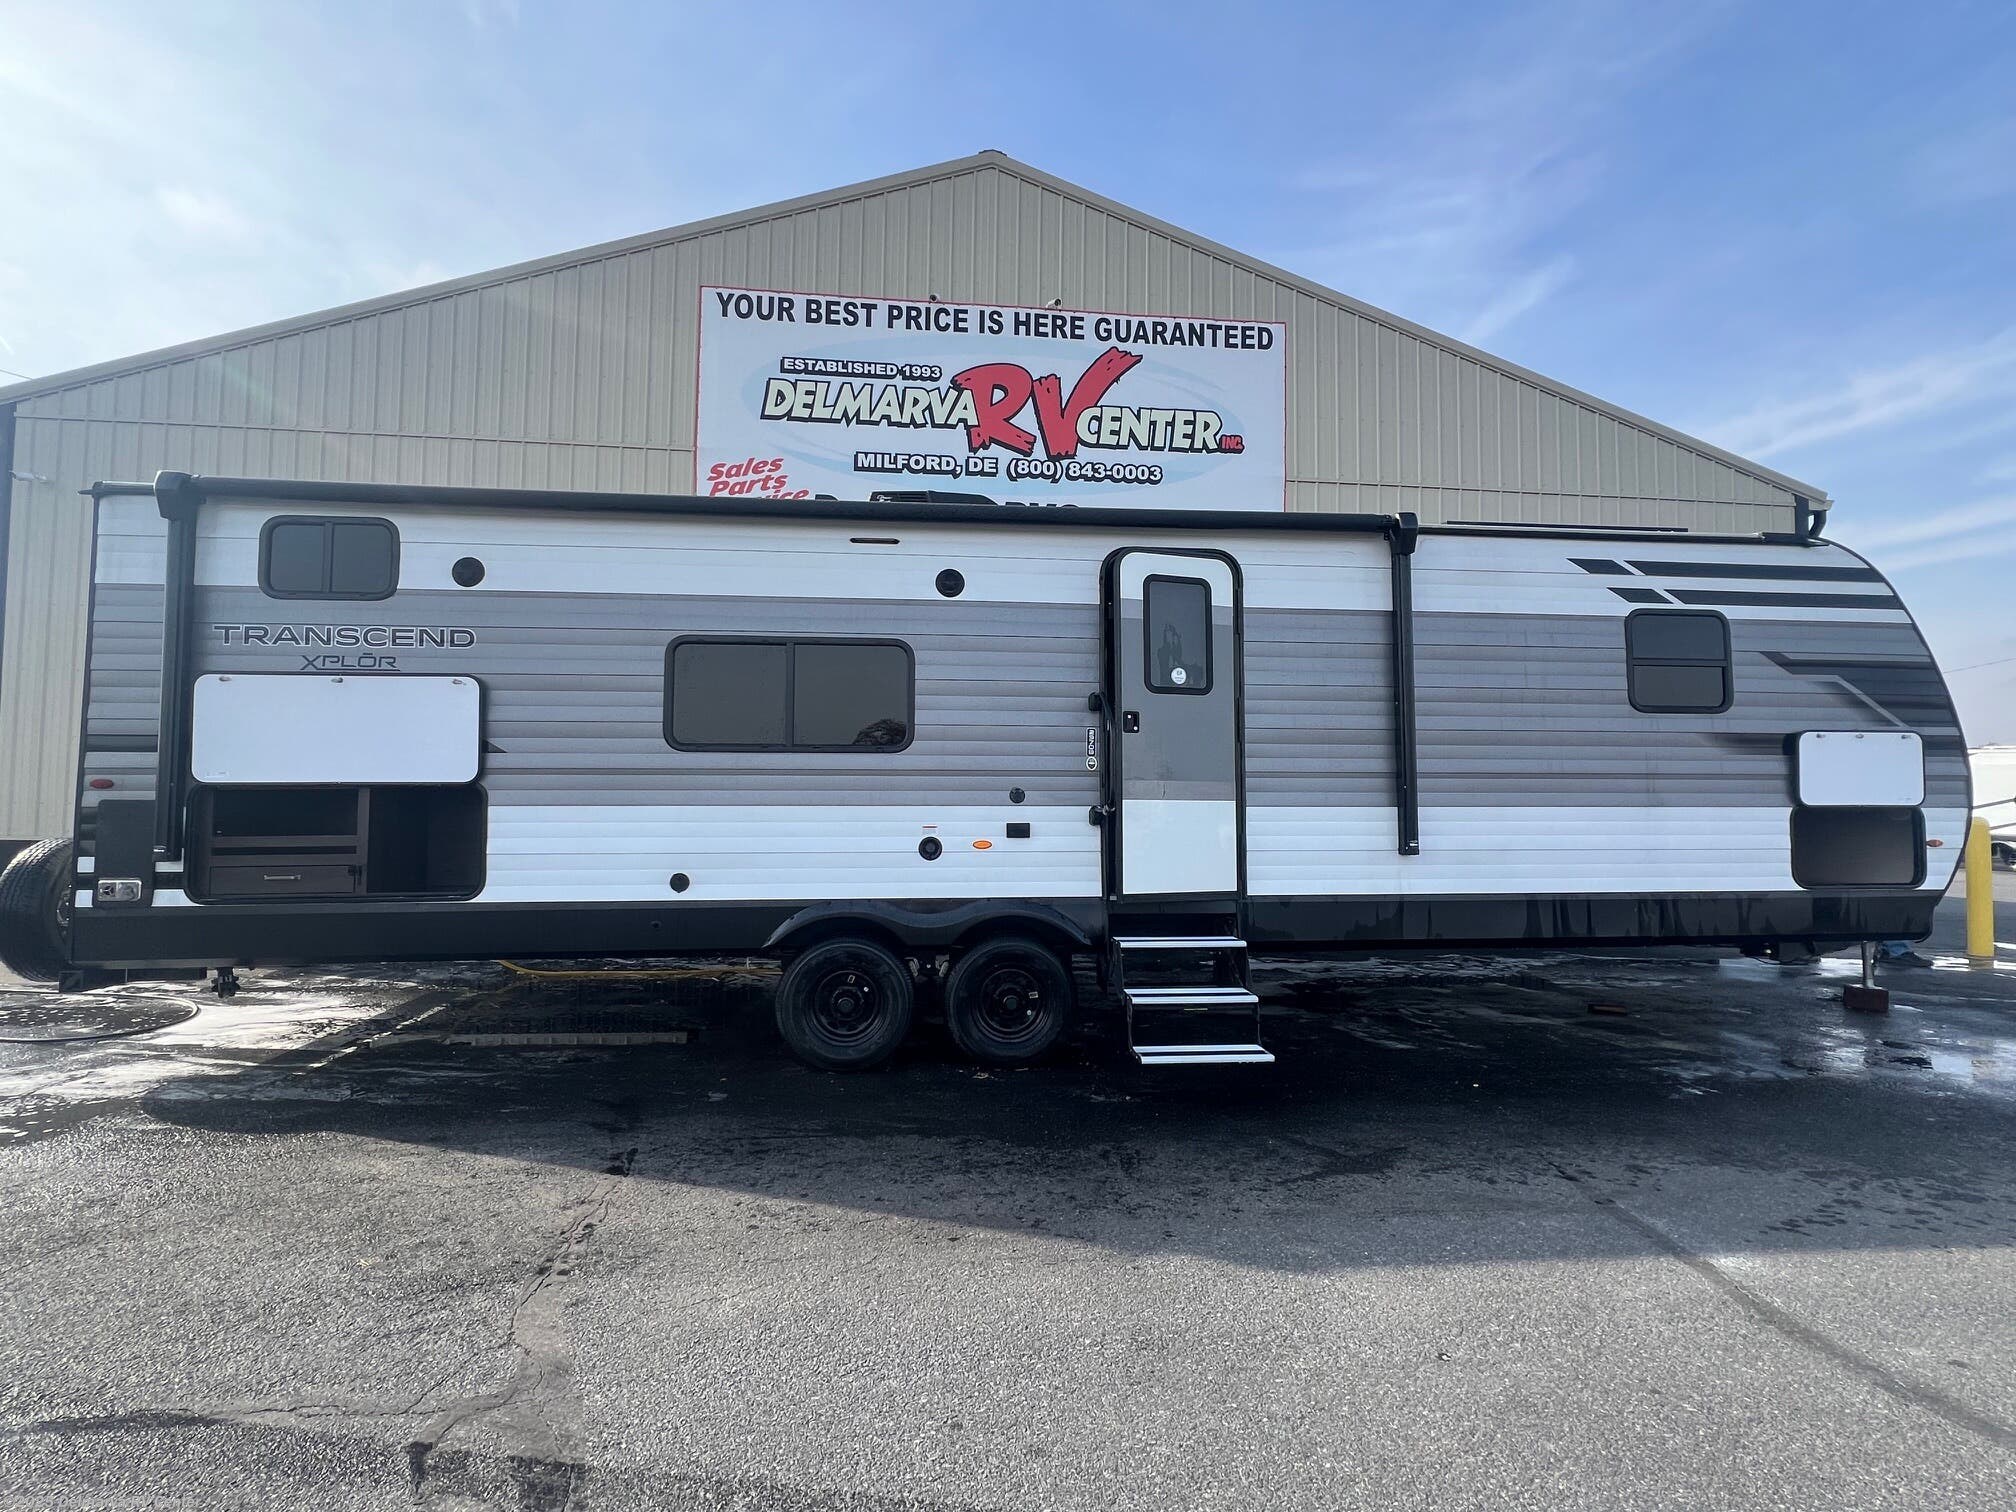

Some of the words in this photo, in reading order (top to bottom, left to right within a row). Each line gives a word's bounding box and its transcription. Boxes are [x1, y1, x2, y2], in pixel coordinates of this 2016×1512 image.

[716, 292, 795, 322] YOUR
[805, 299, 877, 327] BEST
[887, 305, 969, 333] PRICE
[979, 309, 1003, 335] IS
[1013, 311, 1085, 340] HERE
[1094, 317, 1274, 350] GUARANTEED
[783, 358, 898, 376] ESTABLISHED
[902, 366, 942, 379] 1993
[762, 378, 979, 427] DELMARVA
[950, 347, 1143, 460] RV
[1076, 405, 1223, 450] CENTER
[707, 457, 784, 481] Sales
[856, 453, 962, 475] MILFORD,
[968, 458, 998, 474] DE
[1009, 460, 1063, 480] (800)
[1068, 463, 1163, 481] 843-0003
[709, 474, 788, 498] Parts
[213, 624, 476, 648] TRANSCEND
